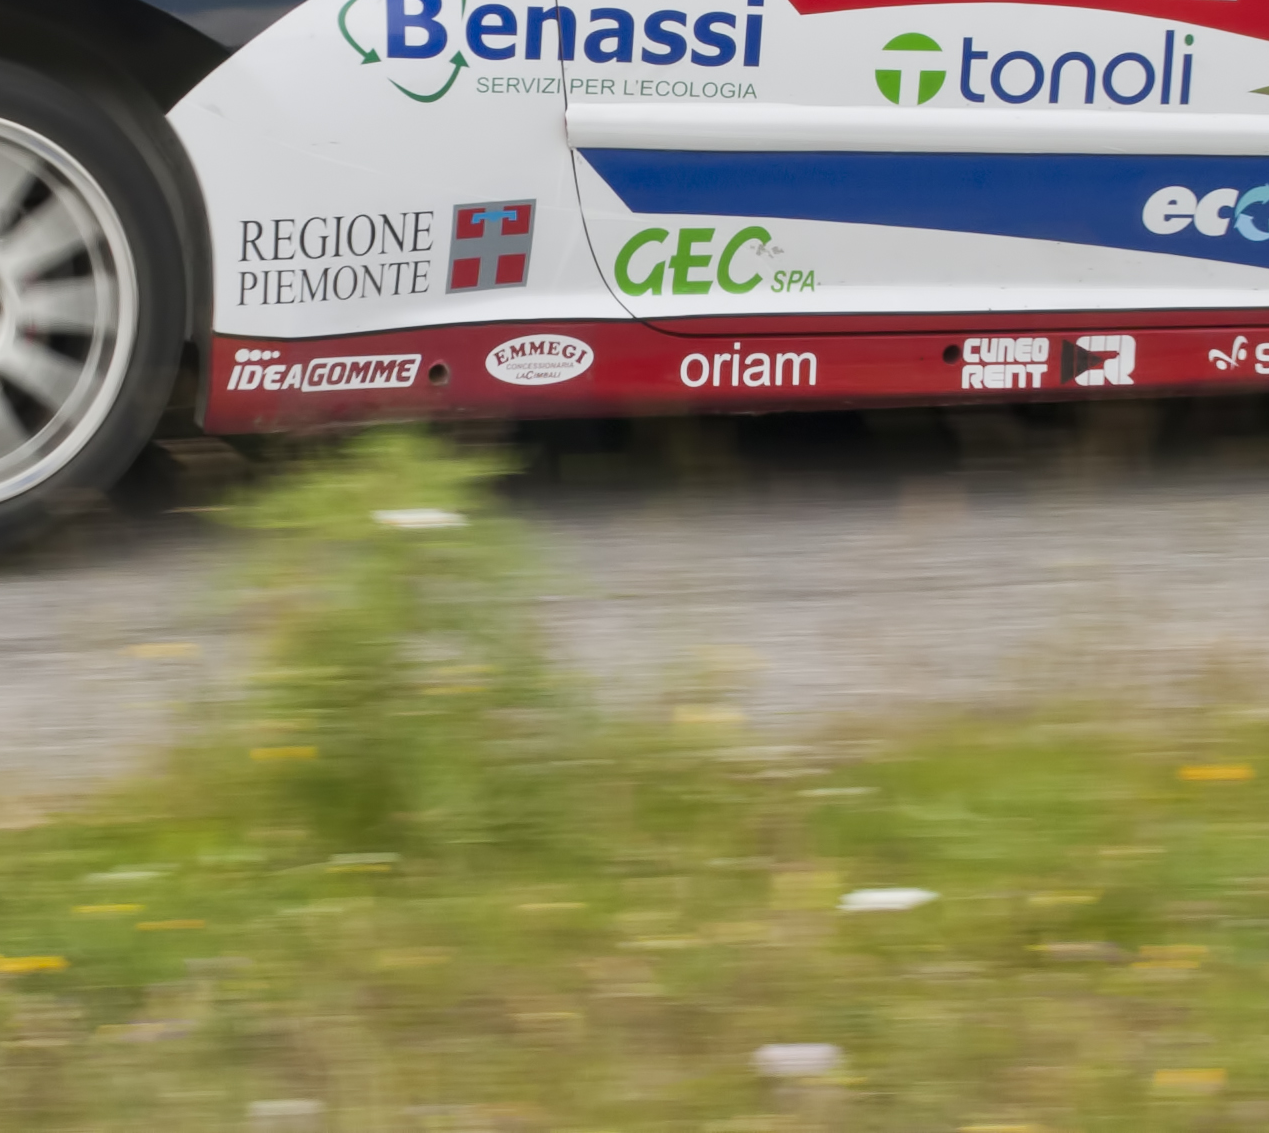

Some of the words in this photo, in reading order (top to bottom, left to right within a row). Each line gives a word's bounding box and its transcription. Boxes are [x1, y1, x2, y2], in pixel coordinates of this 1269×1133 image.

[476, 76, 562, 95] SERVIZI
[569, 78, 616, 96] PER
[623, 79, 758, 99] L'ECOLOGIA
[960, 29, 1195, 106] tonoli
[237, 210, 436, 263] REGIONE
[236, 259, 432, 307] PIEMONTE
[614, 225, 774, 297] GEC
[770, 269, 816, 294] SPA
[493, 340, 588, 367] EMMEGI
[680, 342, 818, 388] oriam
[963, 337, 1050, 363] CUNEO
[961, 363, 1049, 389] RENT
